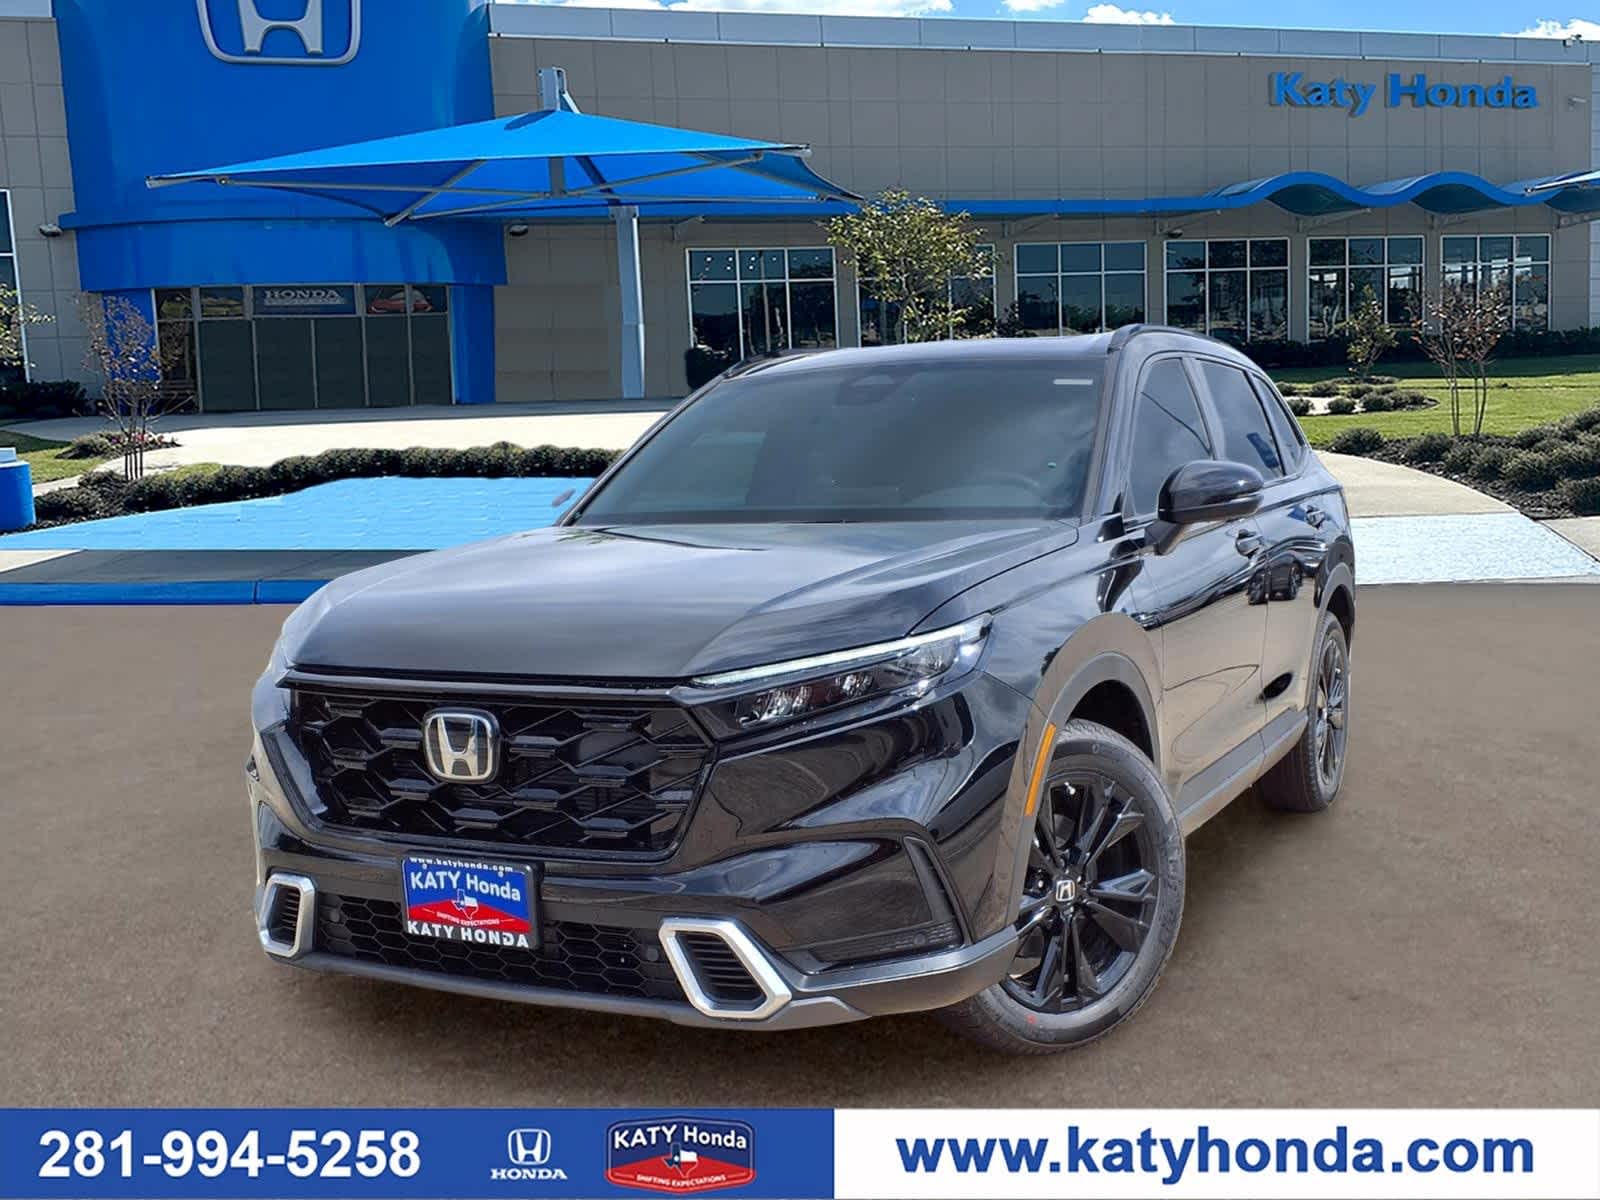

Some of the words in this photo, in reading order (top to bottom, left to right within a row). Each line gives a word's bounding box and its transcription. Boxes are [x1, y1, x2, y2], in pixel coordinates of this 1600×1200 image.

[1270, 72, 1376, 116] Katy
[1386, 73, 1539, 109] Honda
[264, 289, 342, 300] HONDA
[409, 856, 514, 872] www.katyhonda.com
[411, 871, 461, 890] KATY
[466, 873, 521, 902] Honda
[407, 920, 454, 939] KATY
[461, 927, 529, 948] HONDA
